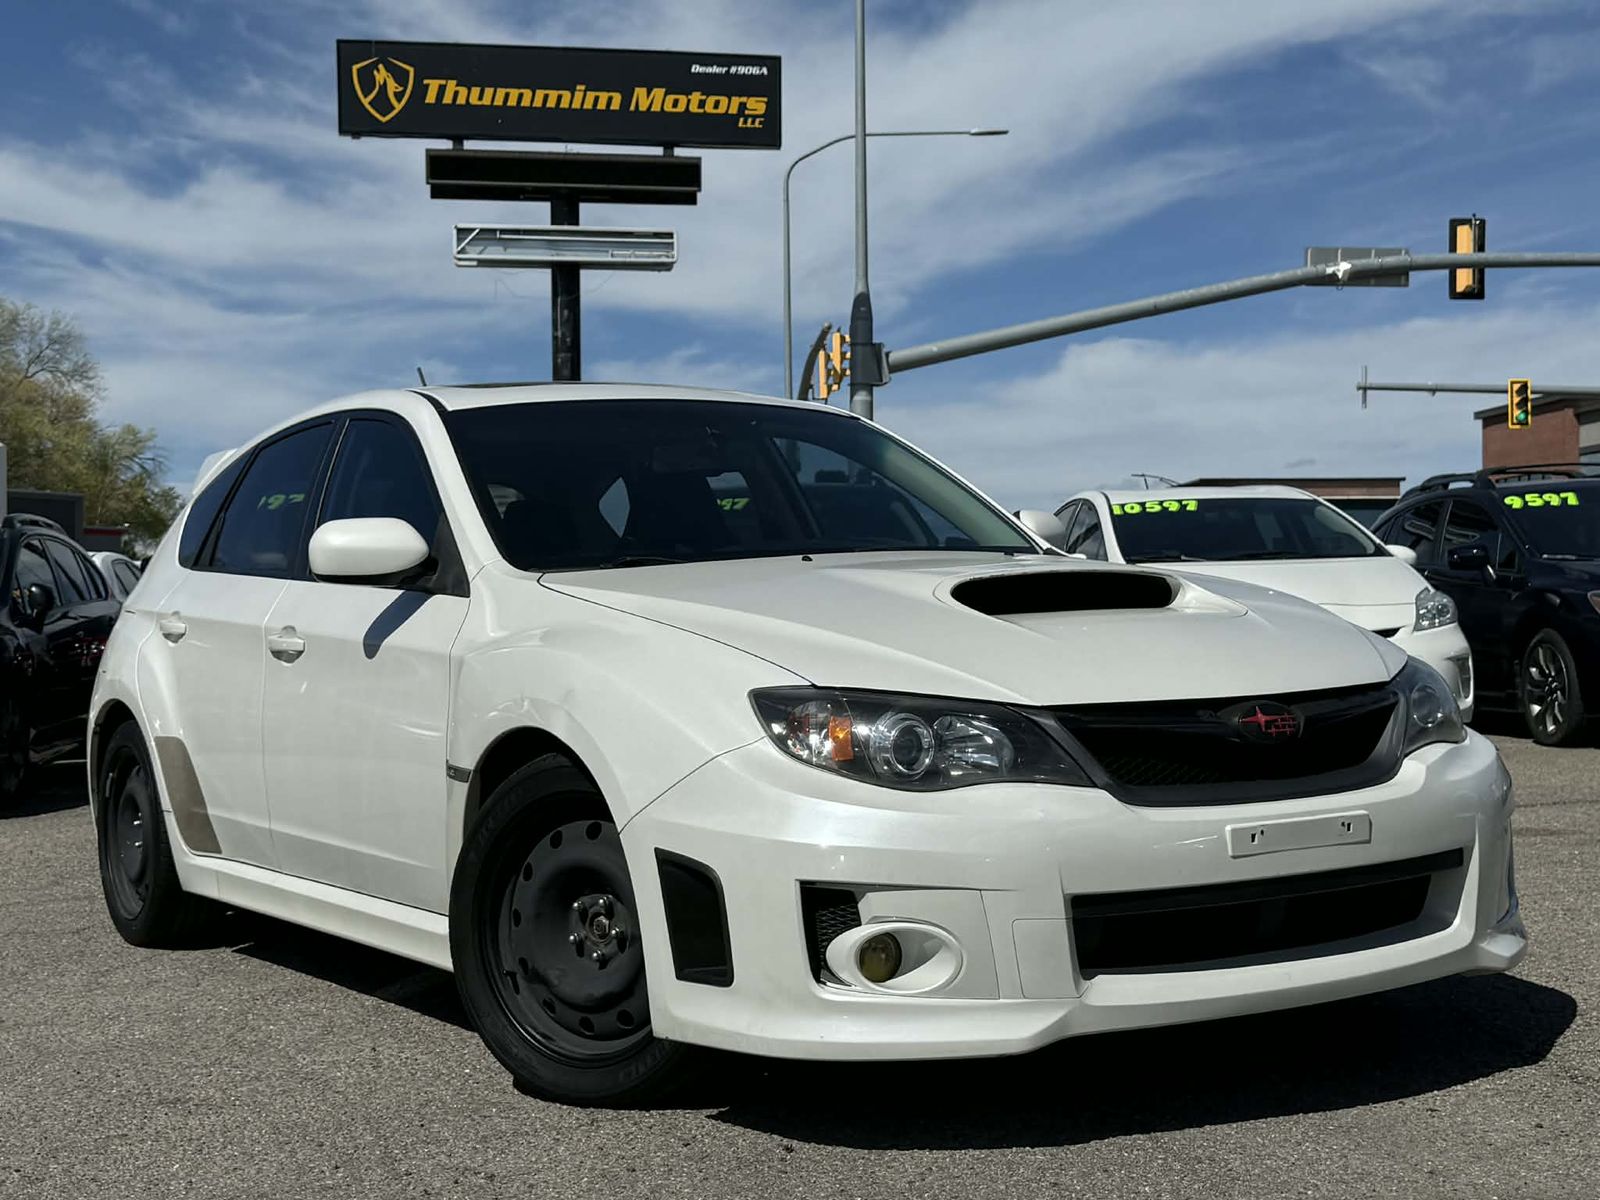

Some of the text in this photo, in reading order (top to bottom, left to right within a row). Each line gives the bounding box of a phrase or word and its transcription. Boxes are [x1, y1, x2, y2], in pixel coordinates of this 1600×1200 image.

[691, 64, 768, 75] Dealer #906A
[423, 79, 768, 116] Thummim Motors
[738, 117, 764, 128] LLC
[1112, 500, 1198, 515] 10597
[1503, 492, 1579, 509] 9597
